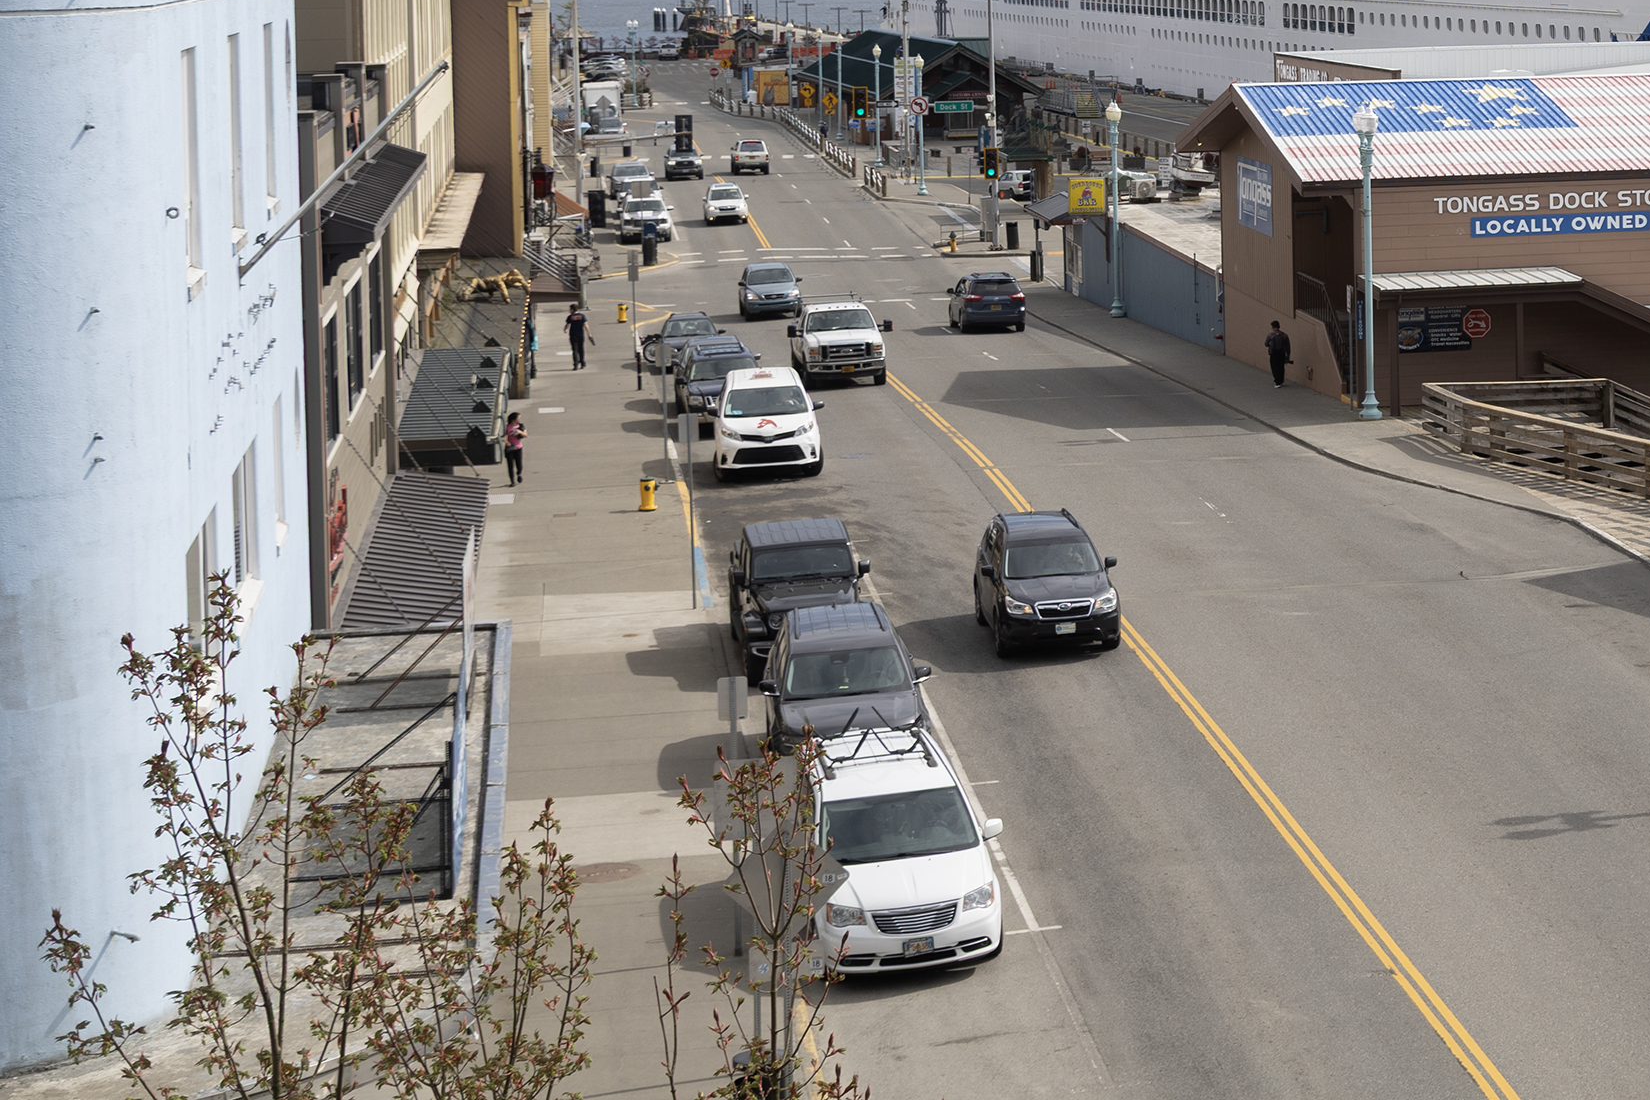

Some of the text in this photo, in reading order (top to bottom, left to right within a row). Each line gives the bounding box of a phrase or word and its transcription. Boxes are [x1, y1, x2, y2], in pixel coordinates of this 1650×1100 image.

[1077, 198, 1097, 206] BAR
[1237, 161, 1272, 226] Tongass
[1434, 193, 1540, 214] TONGASS
[1549, 191, 1609, 210] DOCK
[1475, 214, 1648, 235] LOCALLY OWNED
[812, 960, 820, 968] 18
